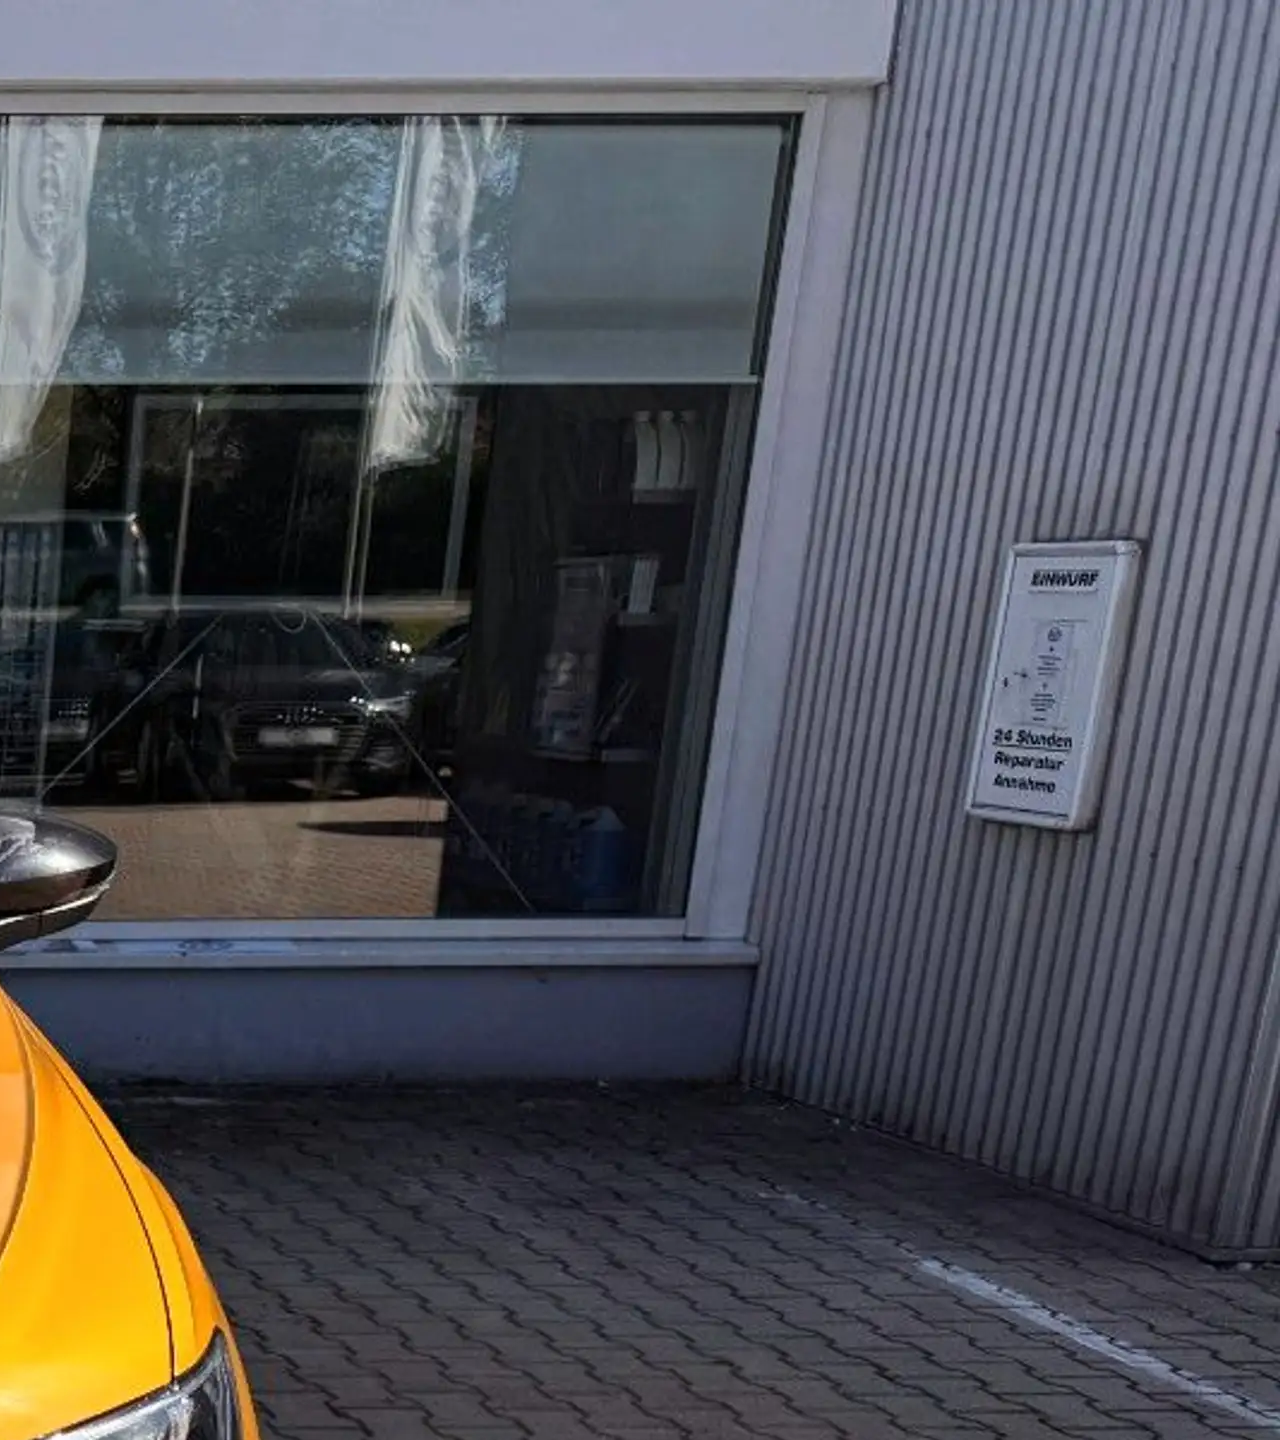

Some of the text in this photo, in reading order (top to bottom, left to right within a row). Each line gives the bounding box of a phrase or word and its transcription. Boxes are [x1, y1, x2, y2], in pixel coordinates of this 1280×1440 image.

[1031, 571, 1100, 588] EINWURF
[1017, 729, 1073, 748] Stunden
[994, 751, 1064, 772] Reparatur
[993, 773, 1056, 794] Annahme
